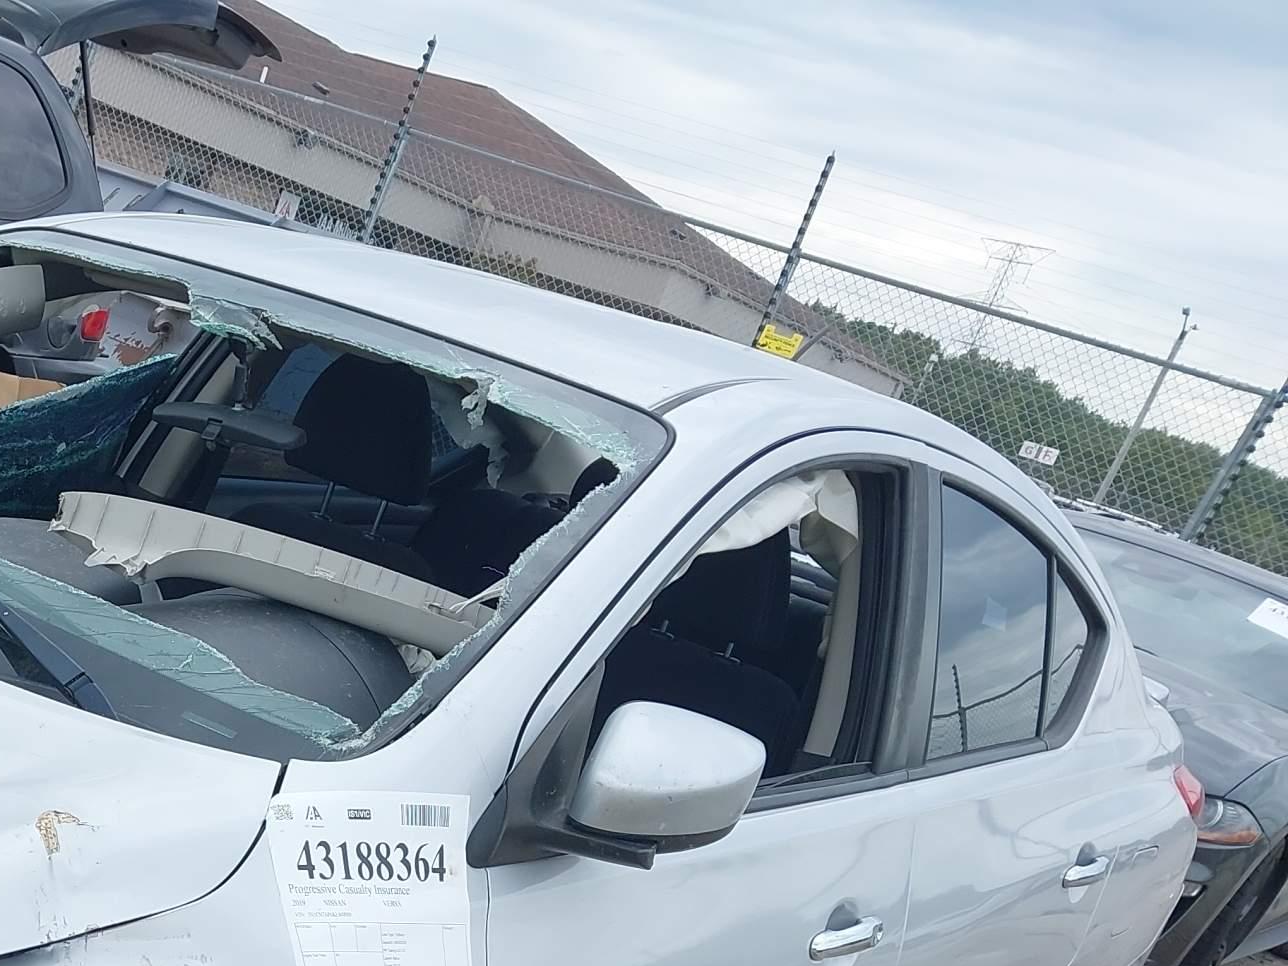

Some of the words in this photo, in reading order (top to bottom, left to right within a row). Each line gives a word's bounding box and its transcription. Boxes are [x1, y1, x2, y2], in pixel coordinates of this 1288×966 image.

[297, 840, 447, 882] 43188364
[288, 883, 336, 896] Progressive
[338, 884, 372, 896] Casualty
[374, 885, 410, 895] Insurance
